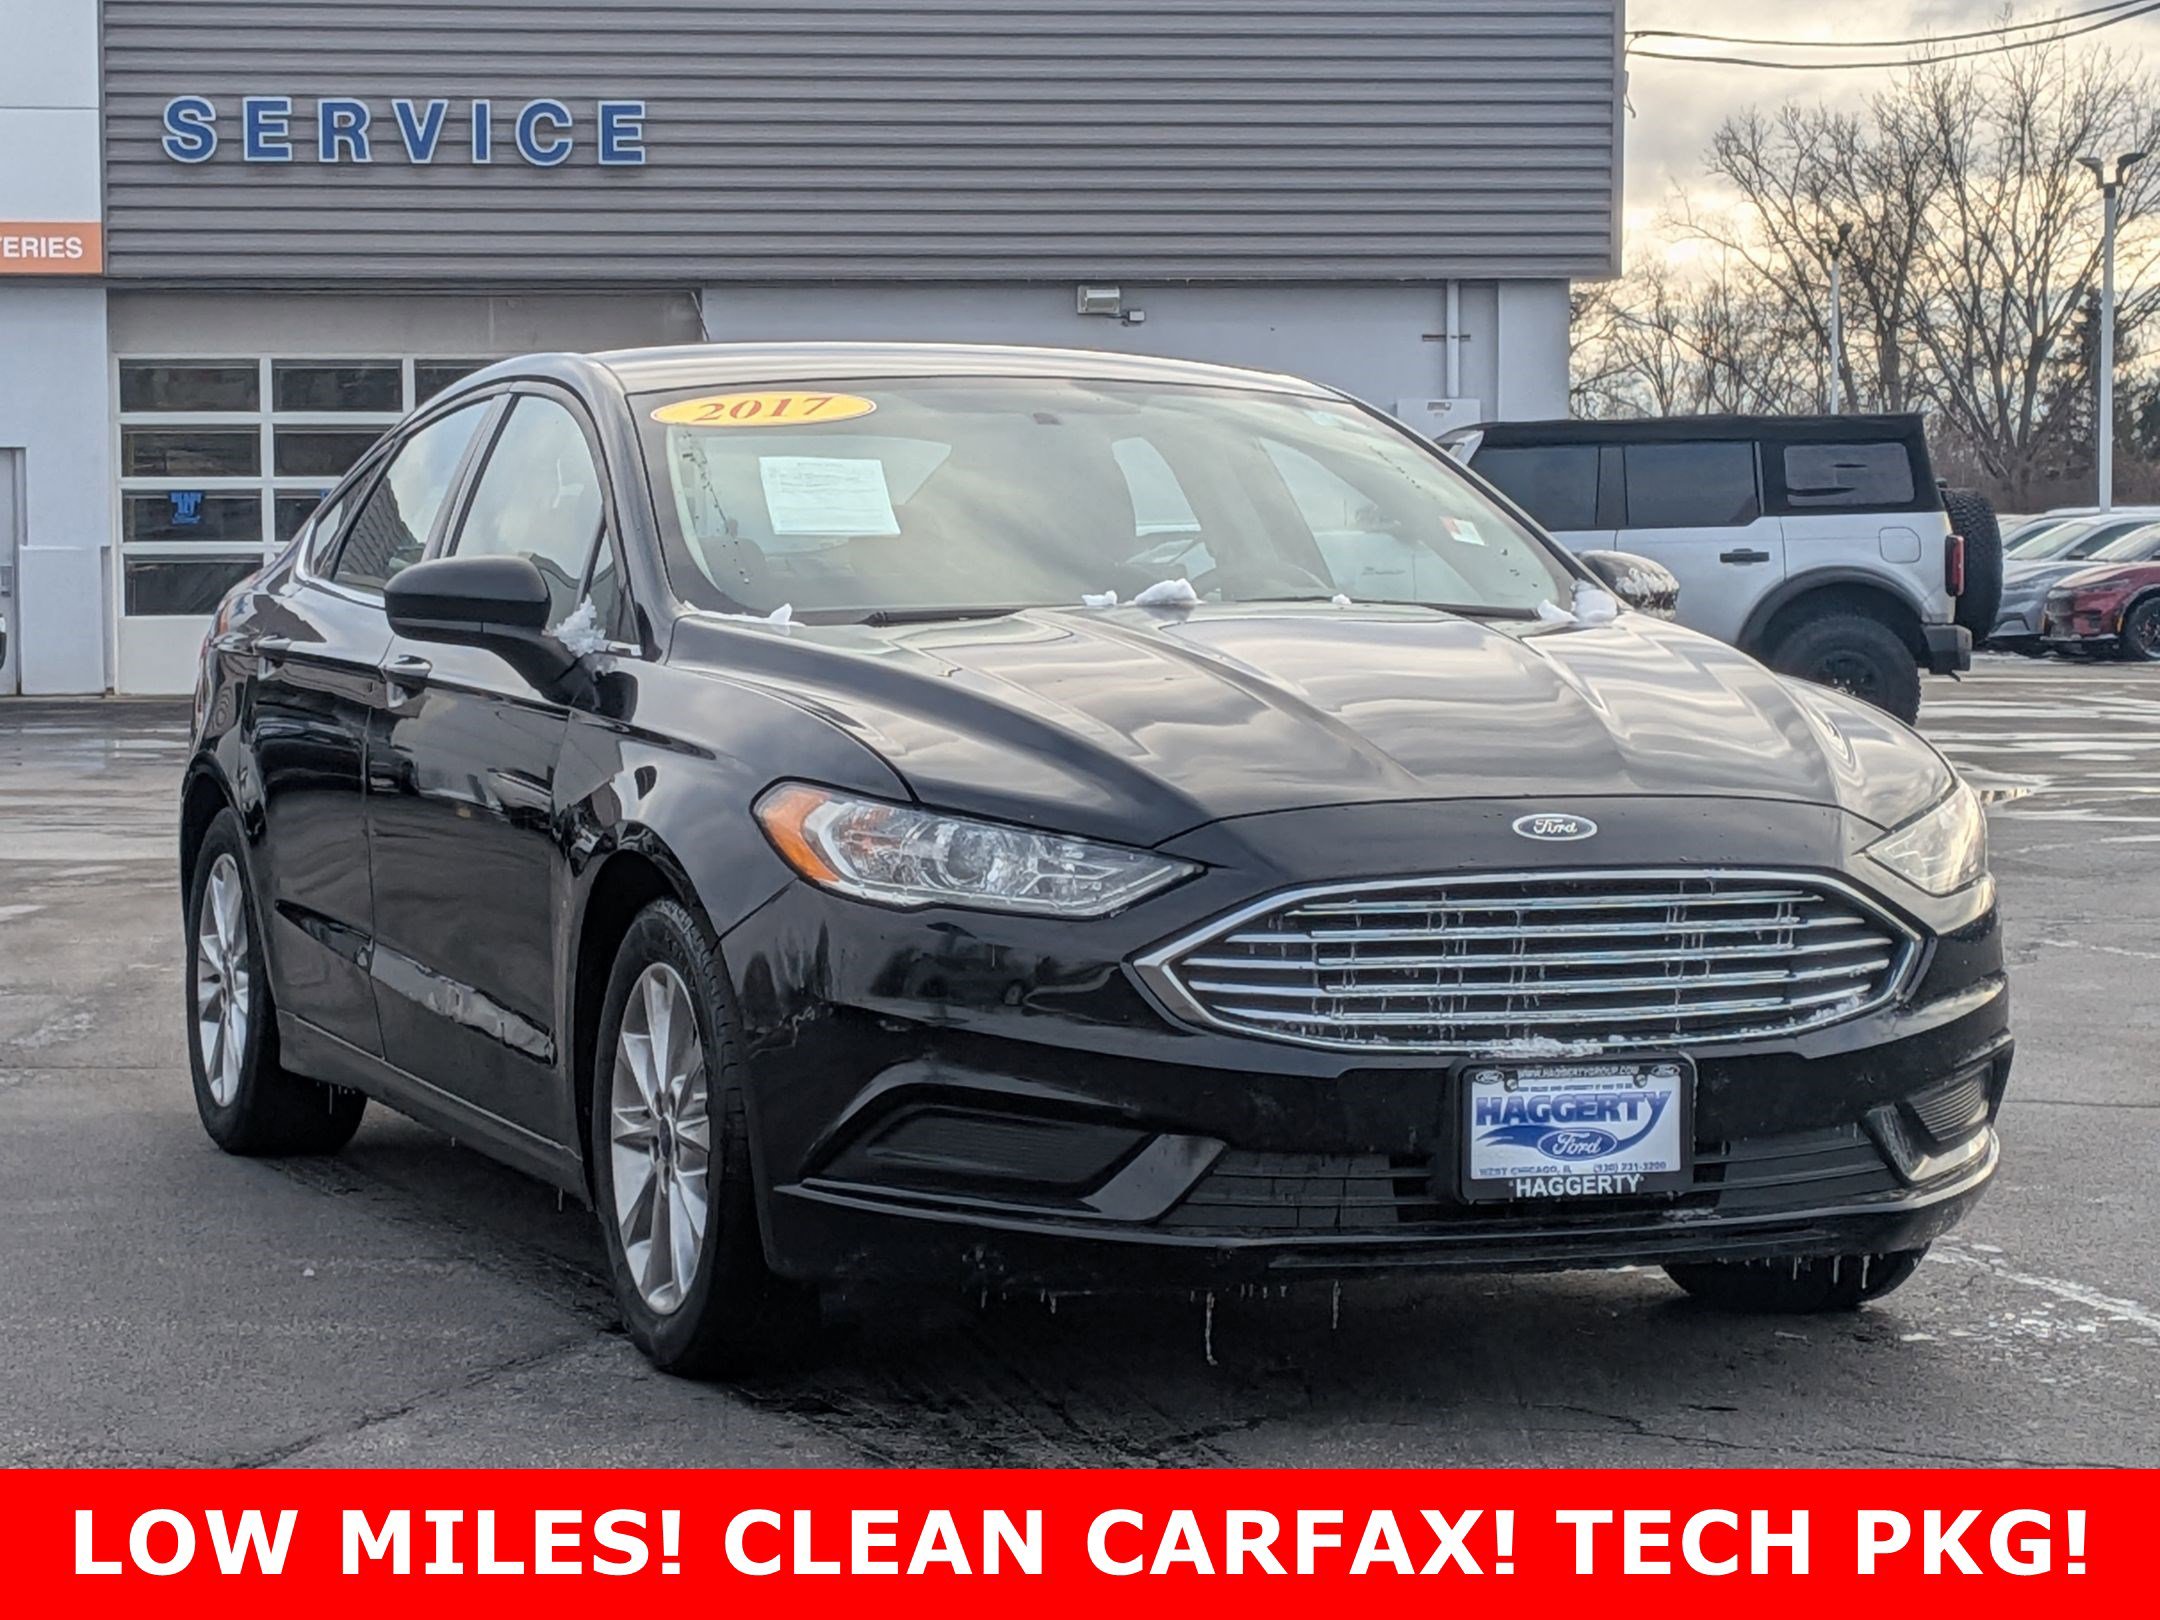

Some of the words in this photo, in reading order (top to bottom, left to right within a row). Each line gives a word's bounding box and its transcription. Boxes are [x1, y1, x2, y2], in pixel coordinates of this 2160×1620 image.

[162, 95, 646, 166] SERVICE
[693, 396, 833, 422] 2017
[1533, 818, 1578, 835] Ford
[1475, 1091, 1672, 1126] HAGGERTY
[1552, 1131, 1602, 1155] Ford
[1515, 1173, 1641, 1198] HAGGERTY
